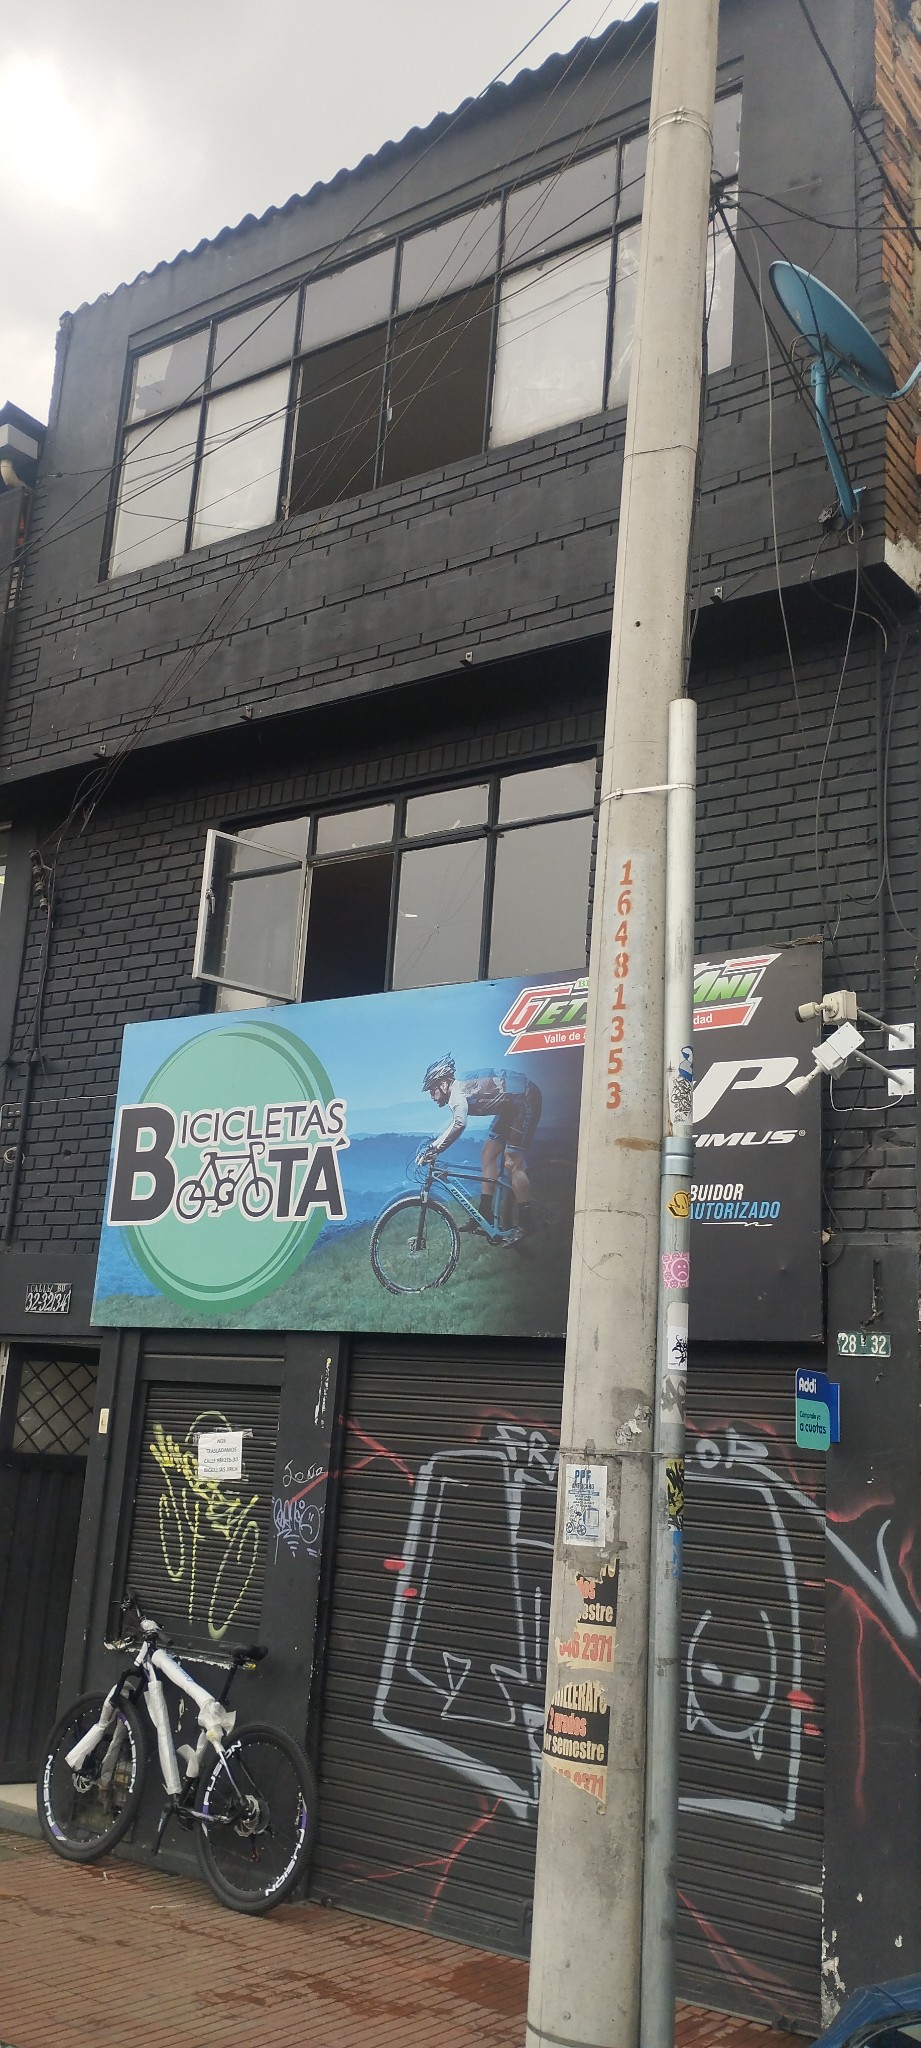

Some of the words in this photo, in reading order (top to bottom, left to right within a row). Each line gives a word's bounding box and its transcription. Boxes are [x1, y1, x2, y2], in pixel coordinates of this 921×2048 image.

[606, 859, 633, 1110] 16481353
[543, 1033, 567, 1044] Valle
[569, 1032, 580, 1041] de
[841, 1334, 857, 1354] 28
[871, 1335, 887, 1355] 32
[798, 1377, 817, 1395] Addi
[799, 1422, 804, 1432] a
[805, 1421, 827, 1435] cuotas
[581, 1632, 613, 1663] 2371
[548, 1706, 555, 1730] 2
[554, 1711, 587, 1738] grados
[552, 1734, 605, 1762] semestre
